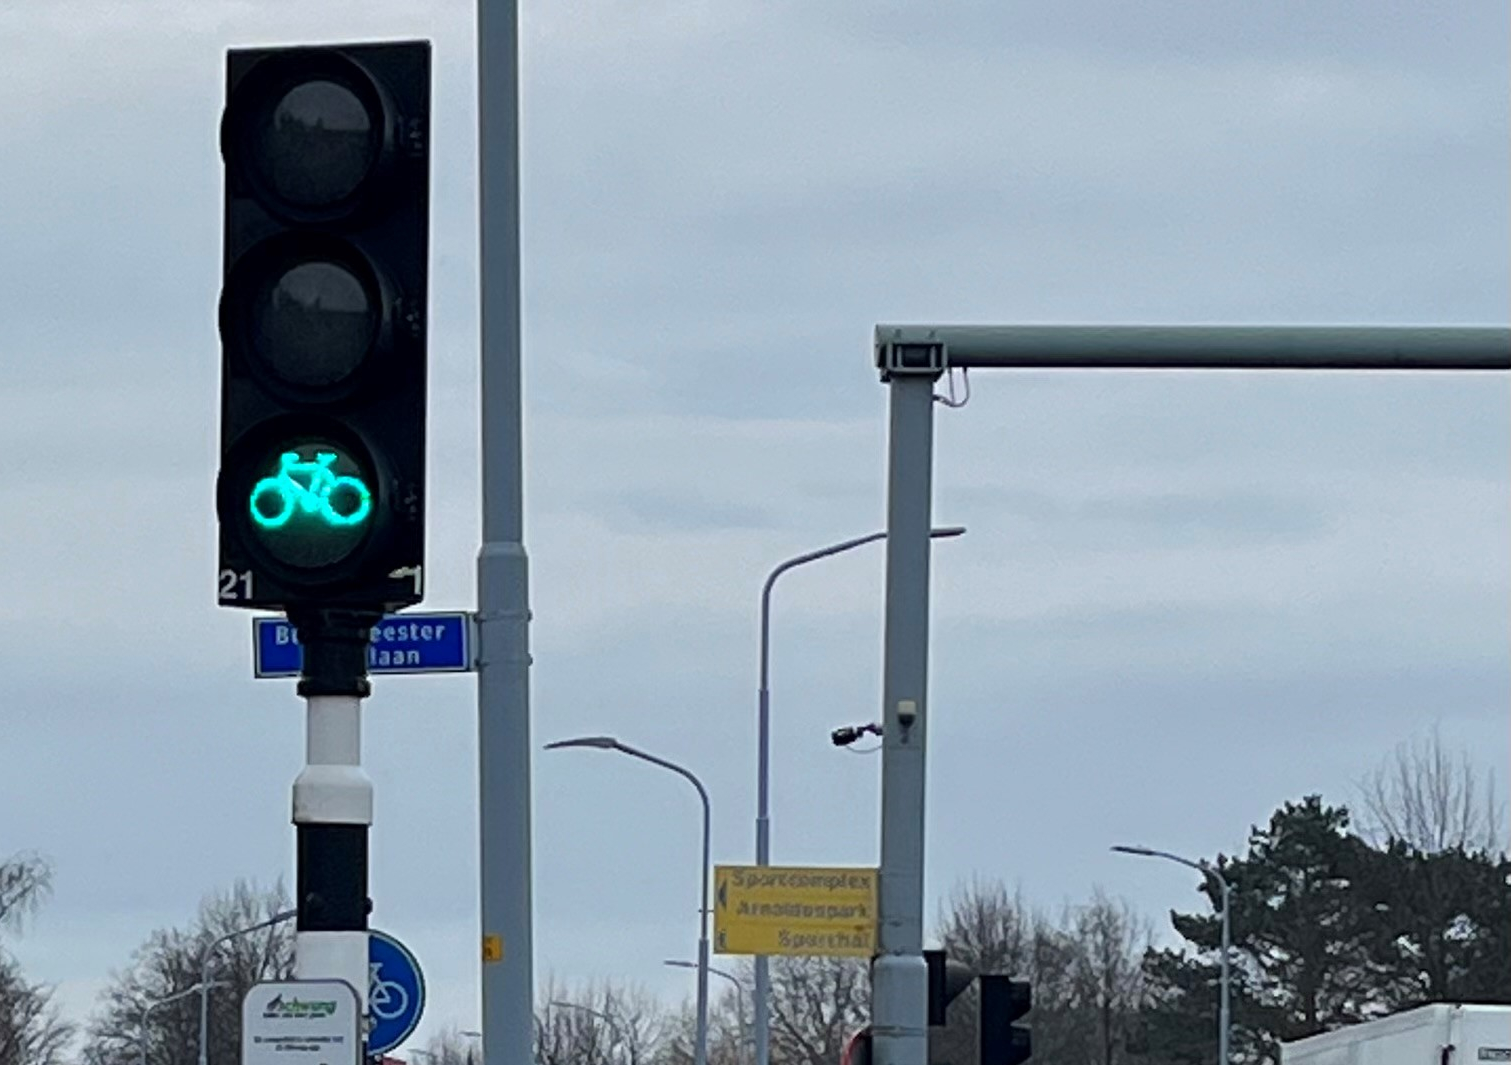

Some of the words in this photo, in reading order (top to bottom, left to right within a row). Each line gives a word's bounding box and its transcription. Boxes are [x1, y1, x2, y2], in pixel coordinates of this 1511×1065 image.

[219, 569, 253, 599] 21
[275, 622, 445, 645] Bueester
[370, 646, 420, 666] laan
